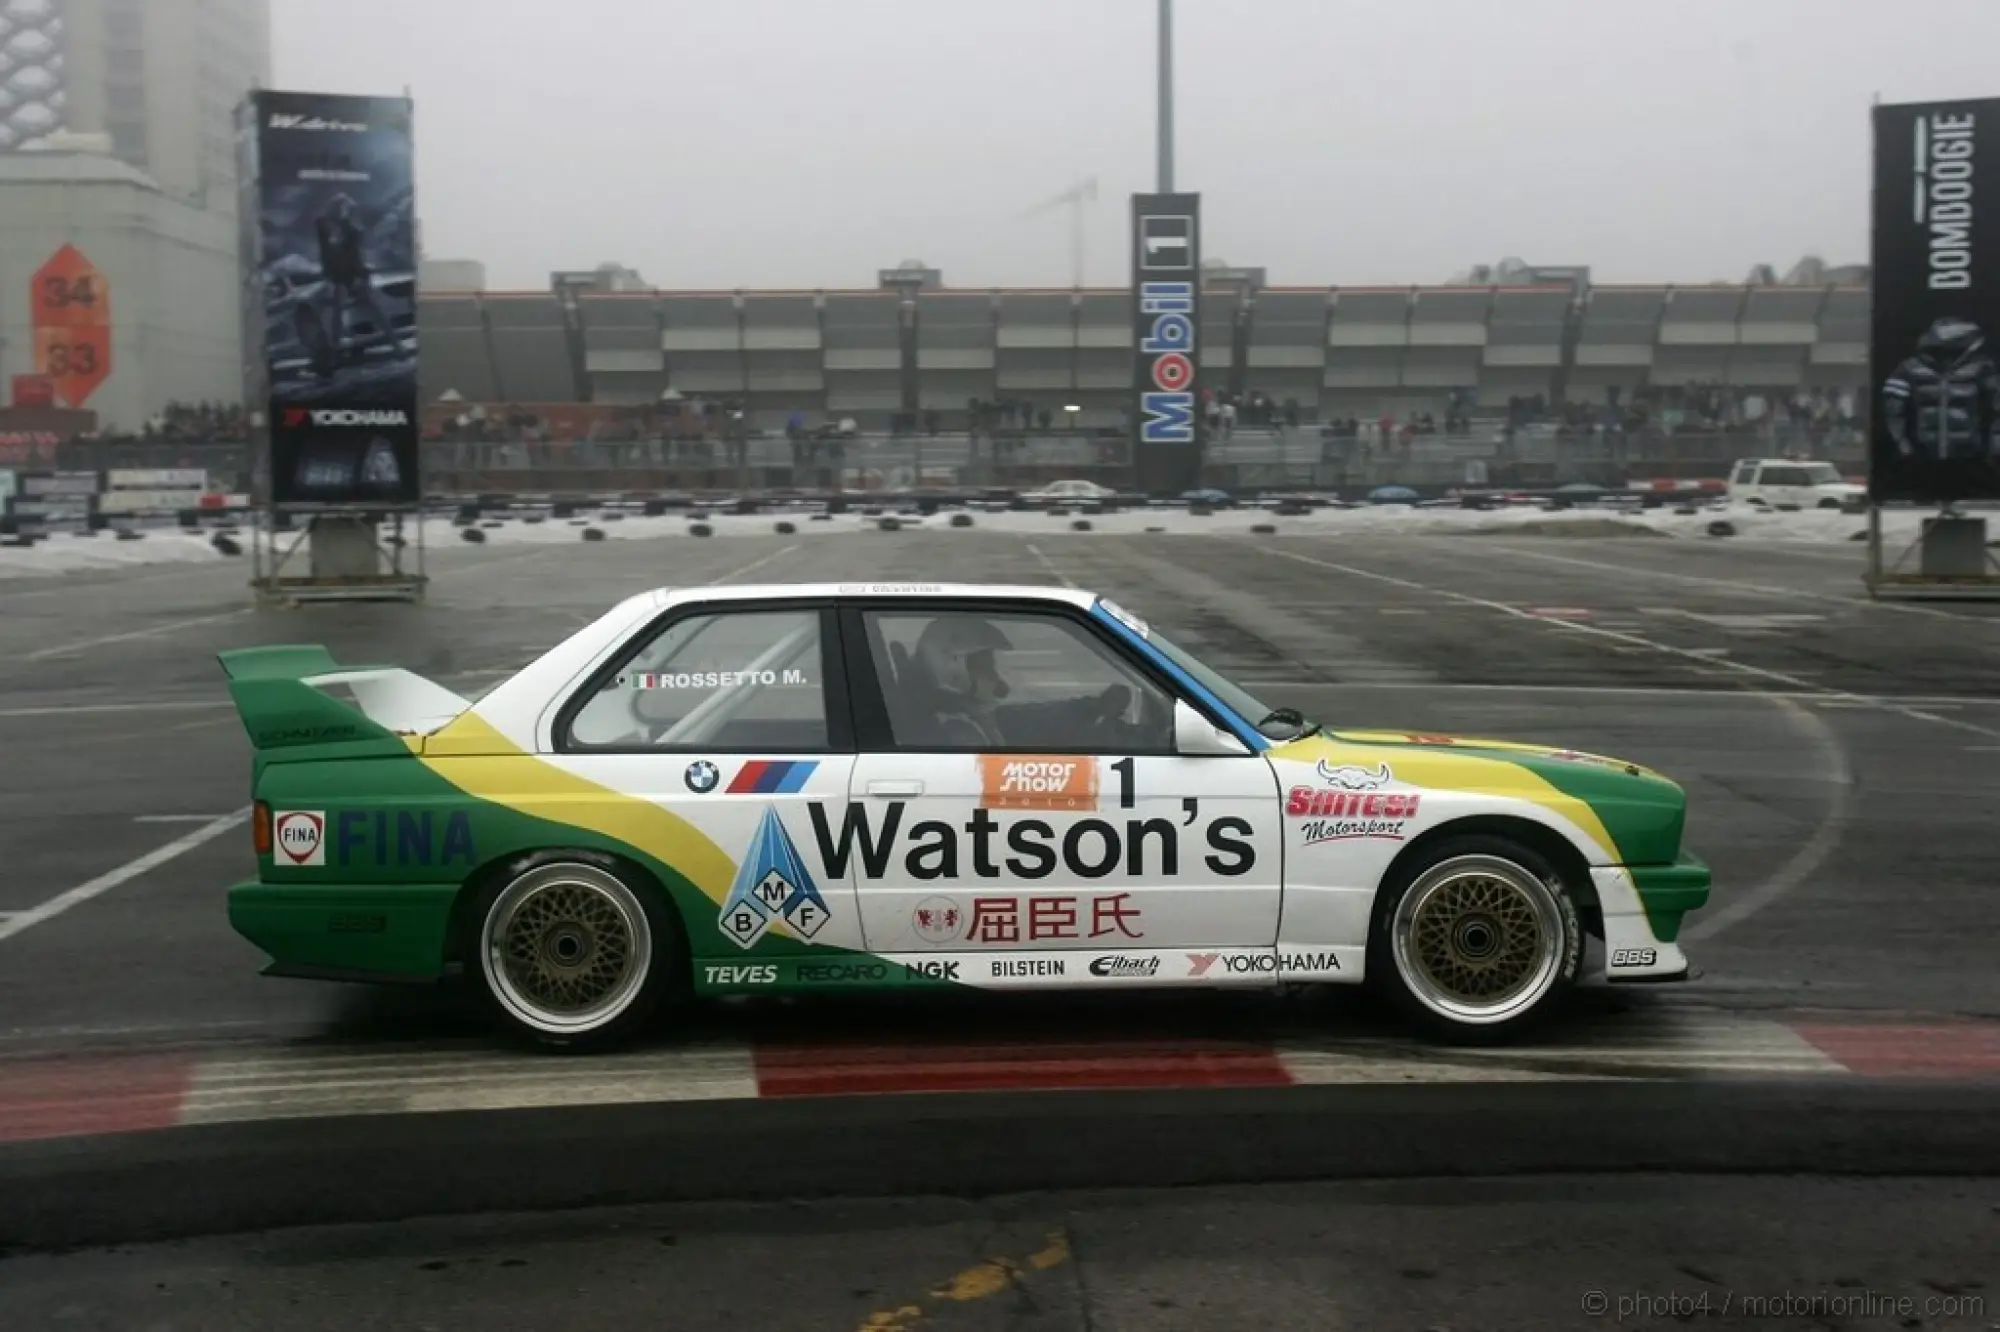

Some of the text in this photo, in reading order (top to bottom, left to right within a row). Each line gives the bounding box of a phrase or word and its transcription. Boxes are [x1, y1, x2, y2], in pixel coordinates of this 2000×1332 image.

[1928, 112, 1975, 289] BOMBOOGIE
[45, 276, 95, 309] 34
[48, 343, 96, 376] 33
[1141, 281, 1194, 443] Mobil
[311, 408, 408, 426] YOKOHAMA
[660, 669, 807, 689] ROSSETTO M.
[1110, 757, 1135, 809] 1
[284, 827, 316, 843] FINA
[338, 810, 478, 867] FINA
[808, 797, 1256, 880] Watson's
[1301, 819, 1405, 841] Motorsport
[965, 892, 1144, 943] 屈臣氏
[797, 964, 888, 982] RECARO
[905, 961, 960, 980] NGK
[991, 960, 1066, 977] BILSTEIN
[1088, 955, 1161, 977] Eibach
[1222, 953, 1341, 972] YOKOHAMA
[704, 965, 779, 984] TEVES
